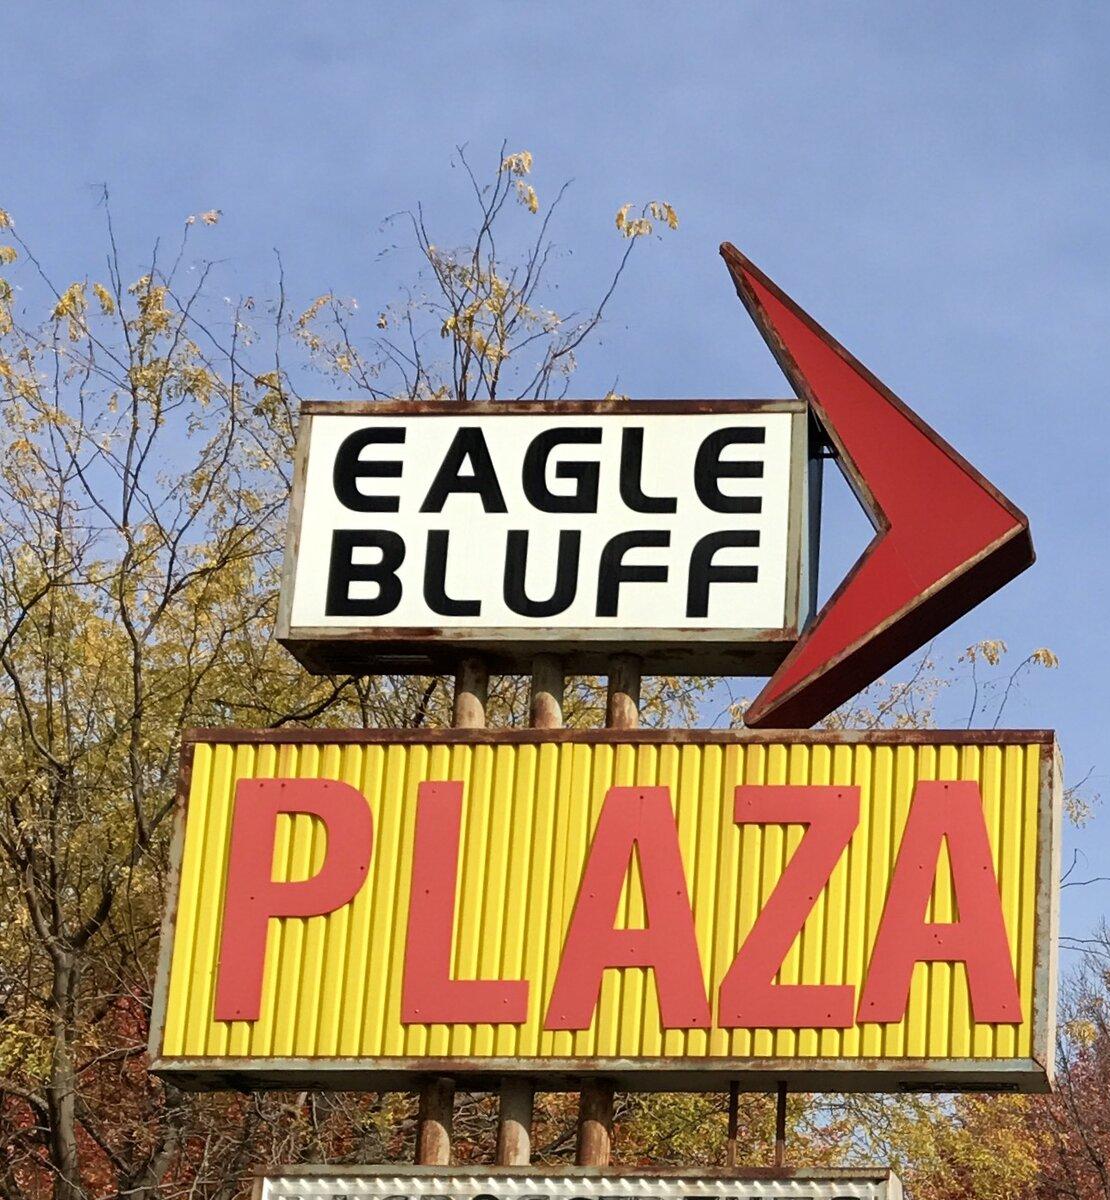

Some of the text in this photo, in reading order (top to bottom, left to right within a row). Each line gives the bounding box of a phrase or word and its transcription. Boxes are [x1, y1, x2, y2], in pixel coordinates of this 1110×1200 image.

[332, 425, 767, 515] EAGLE
[324, 529, 762, 618] BLUFF
[213, 777, 1023, 1031] PLAZA
